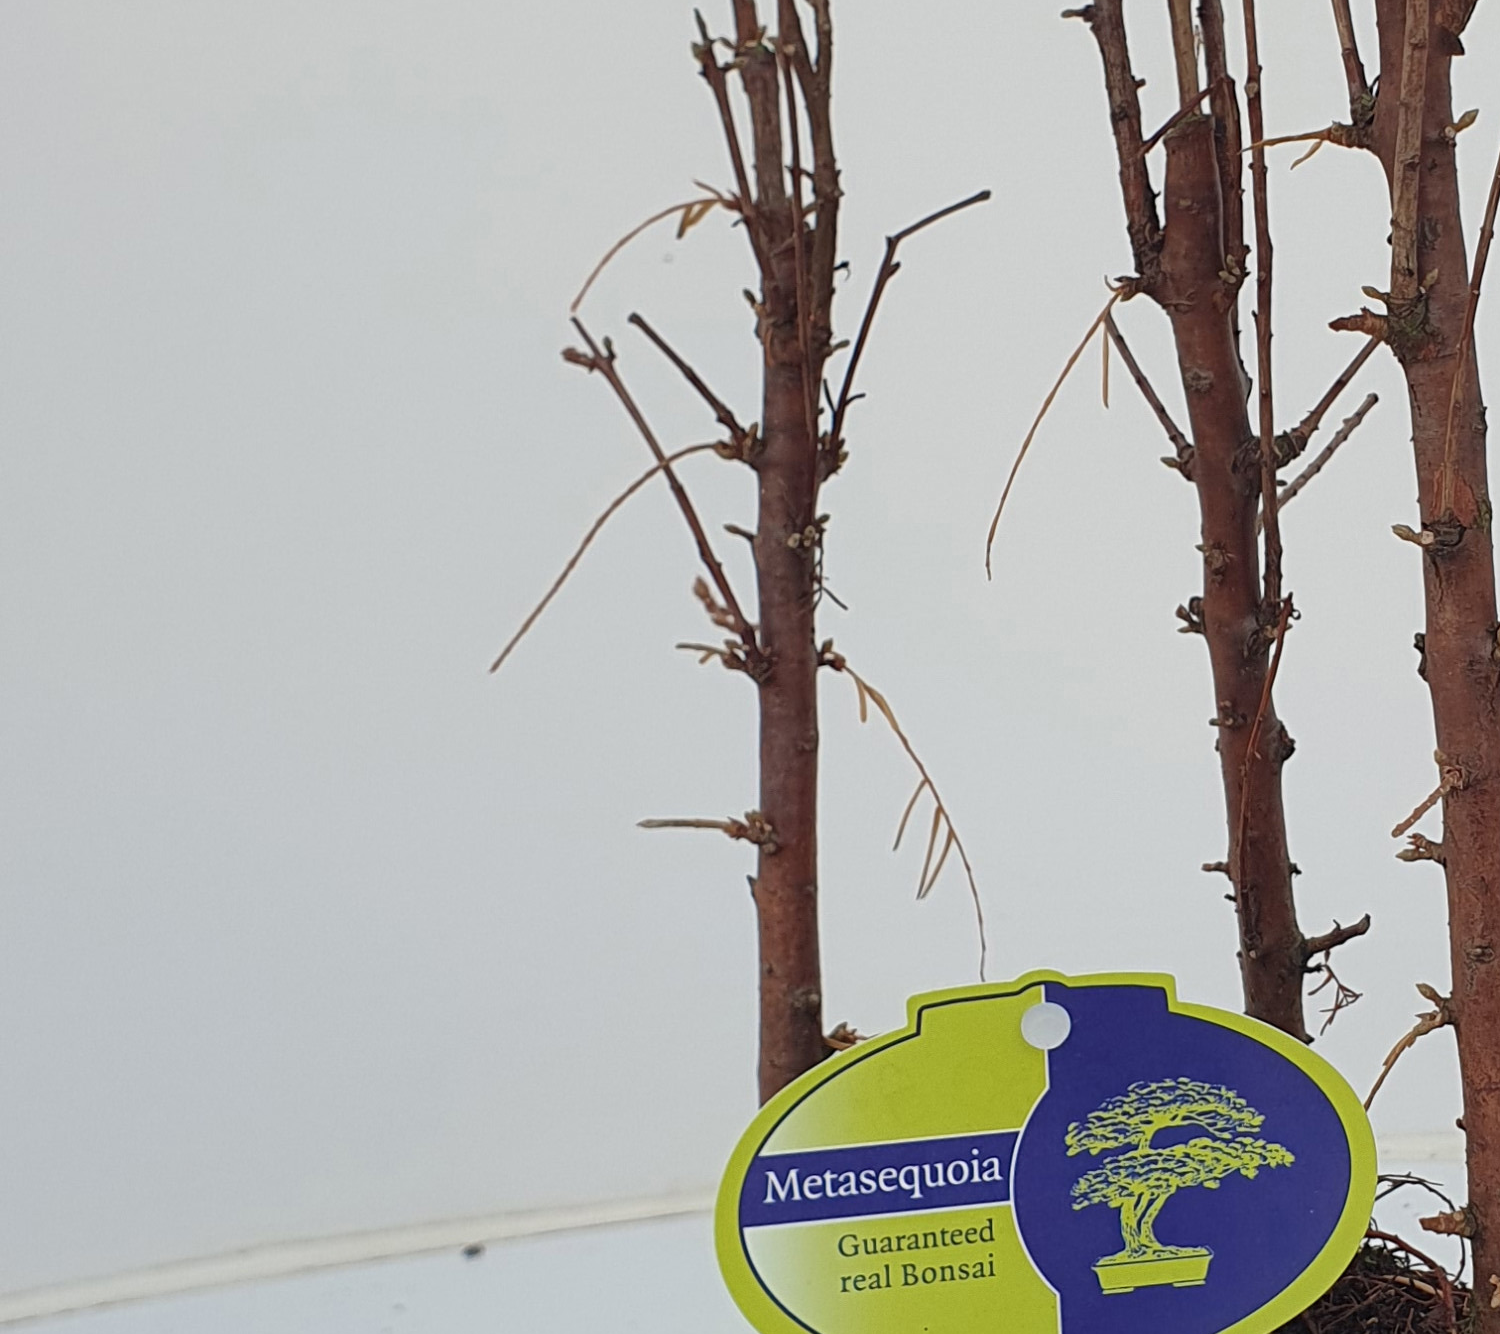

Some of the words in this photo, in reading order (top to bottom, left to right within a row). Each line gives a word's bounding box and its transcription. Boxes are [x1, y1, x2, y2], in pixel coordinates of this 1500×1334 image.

[762, 1148, 1003, 1204] Metasequoia
[837, 1218, 996, 1257] Guaranteed
[839, 1264, 891, 1293] real
[901, 1253, 996, 1287] Bonsai
